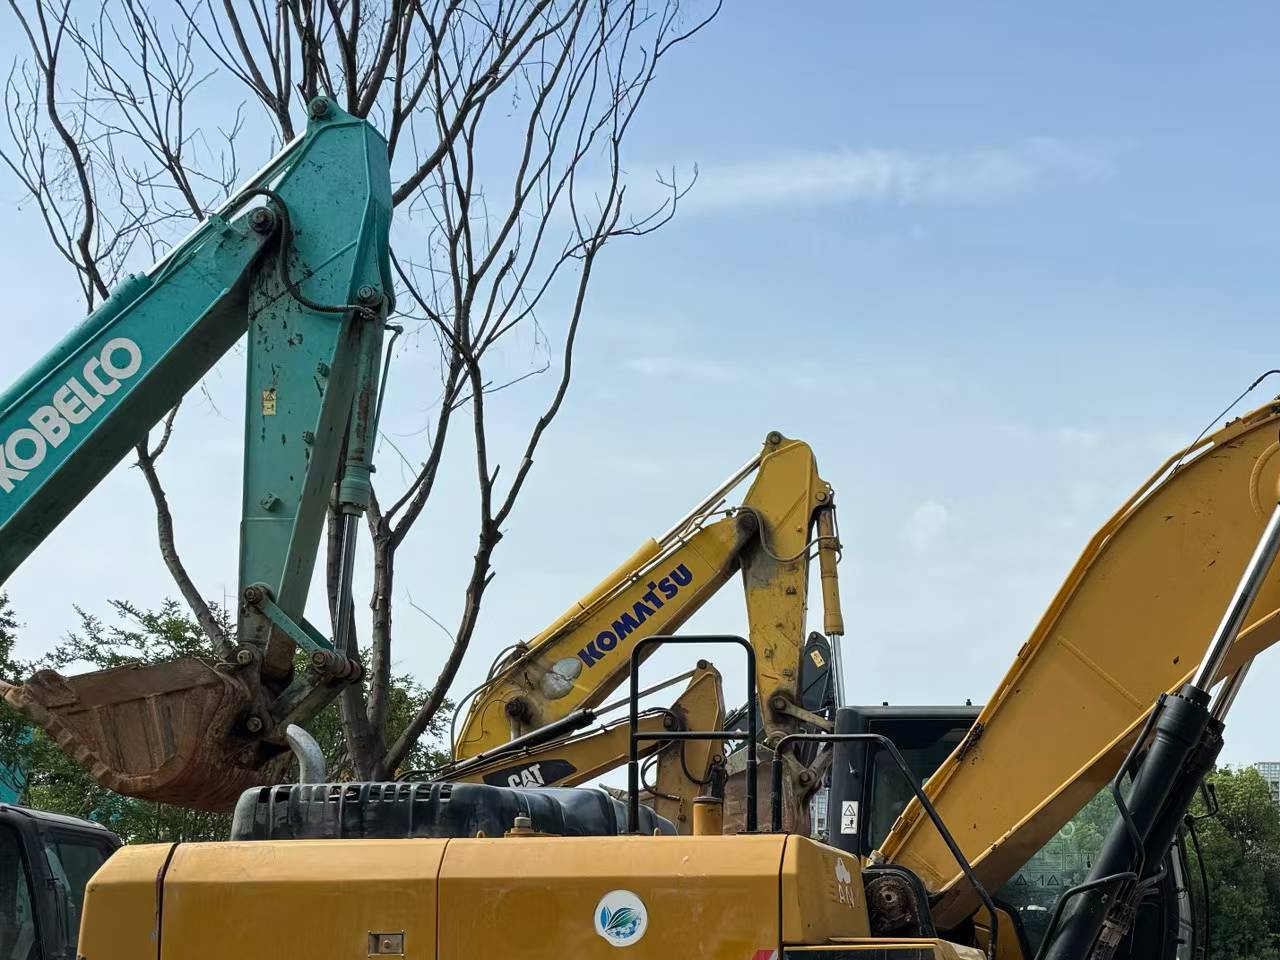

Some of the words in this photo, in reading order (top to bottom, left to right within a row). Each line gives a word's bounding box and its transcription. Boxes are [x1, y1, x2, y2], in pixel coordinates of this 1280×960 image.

[0, 337, 142, 494] KOBELCO
[577, 563, 693, 668] KOMATSU
[507, 763, 545, 789] CAT
